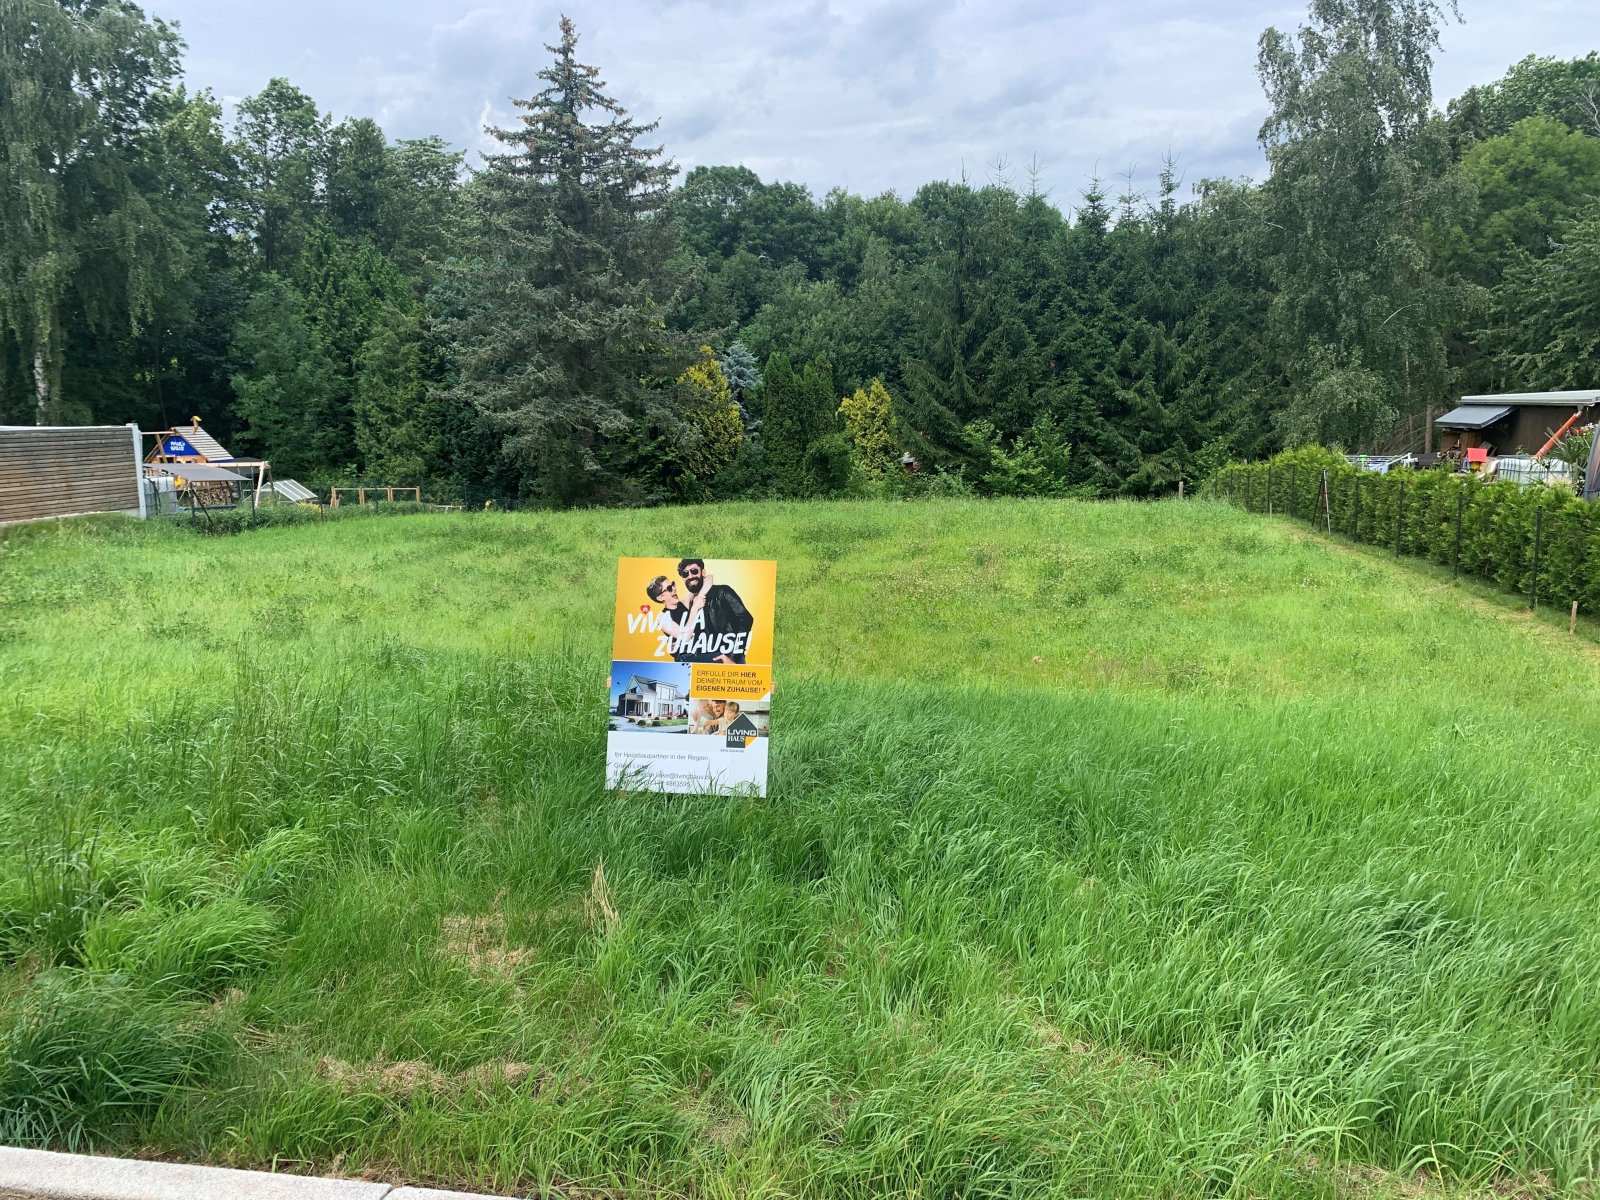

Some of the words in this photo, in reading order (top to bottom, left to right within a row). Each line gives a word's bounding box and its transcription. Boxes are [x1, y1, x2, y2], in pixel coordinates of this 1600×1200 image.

[679, 608, 706, 633] LA
[653, 631, 753, 658] ZUHAUSE!
[696, 669, 726, 678] ERFÜLLE
[623, 752, 669, 760] Hausbaupartner
